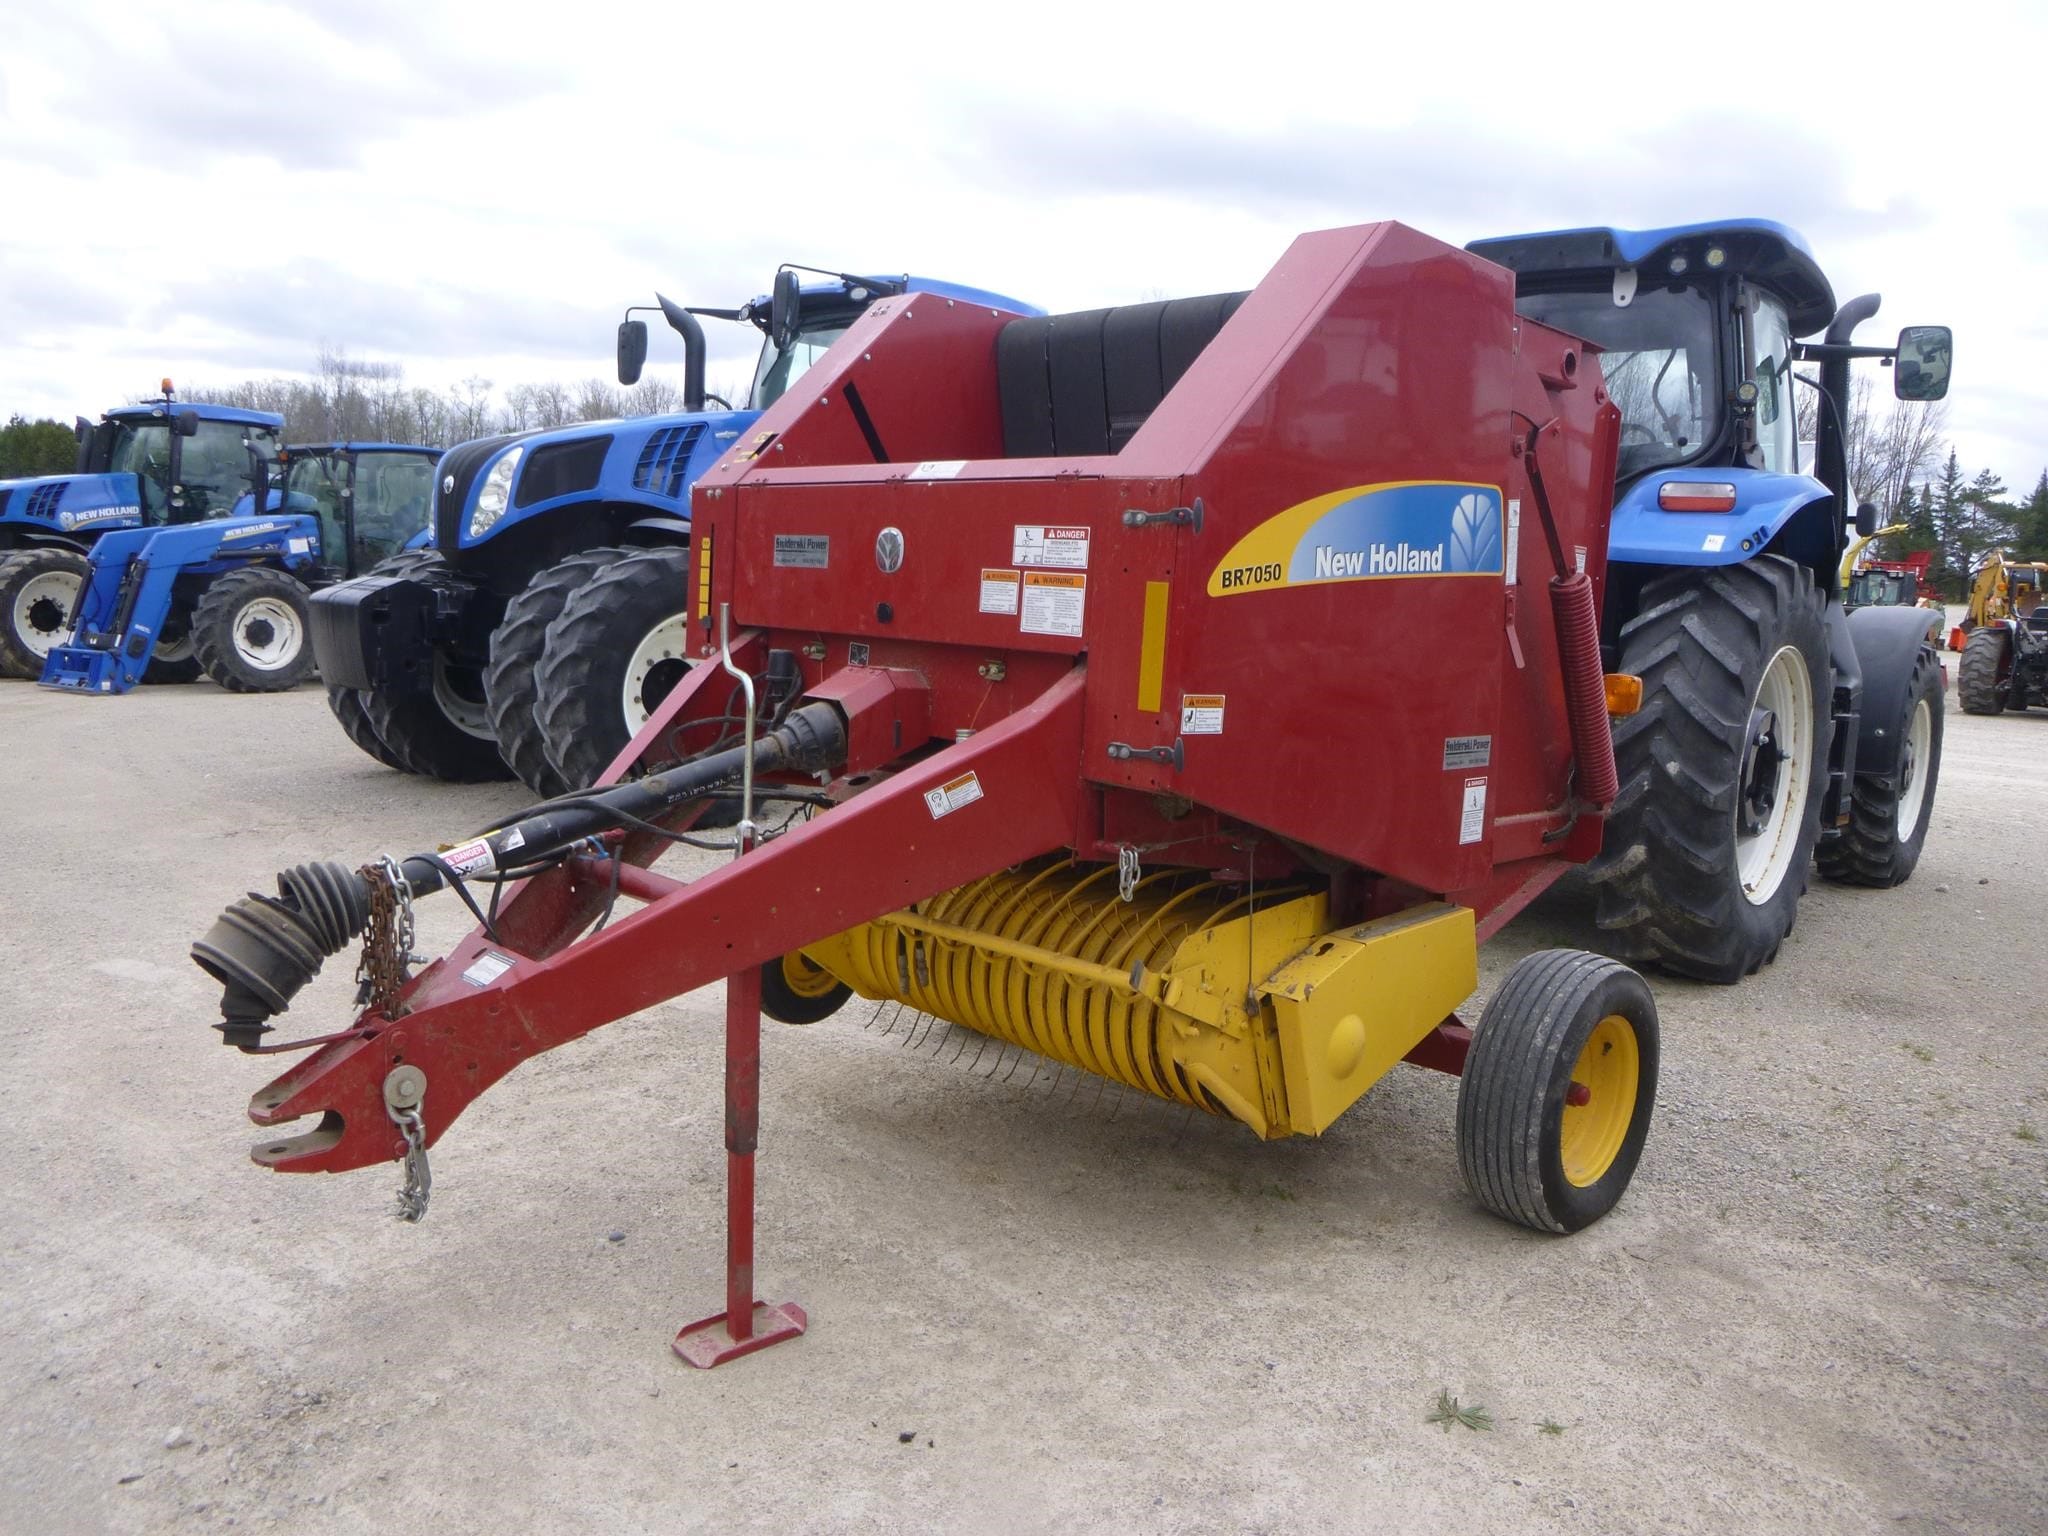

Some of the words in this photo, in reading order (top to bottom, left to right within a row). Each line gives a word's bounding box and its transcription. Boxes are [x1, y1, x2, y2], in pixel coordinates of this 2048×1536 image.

[76, 508, 98, 520] NEW
[99, 506, 139, 517] HOLLAND
[242, 522, 274, 533] HOLLAND
[1056, 530, 1085, 539] DANGER
[1315, 546, 1364, 577] New
[1369, 542, 1443, 573] Holland
[1042, 576, 1074, 586] WARNING
[1221, 563, 1281, 589] BR7050
[454, 846, 485, 862] DANGER
